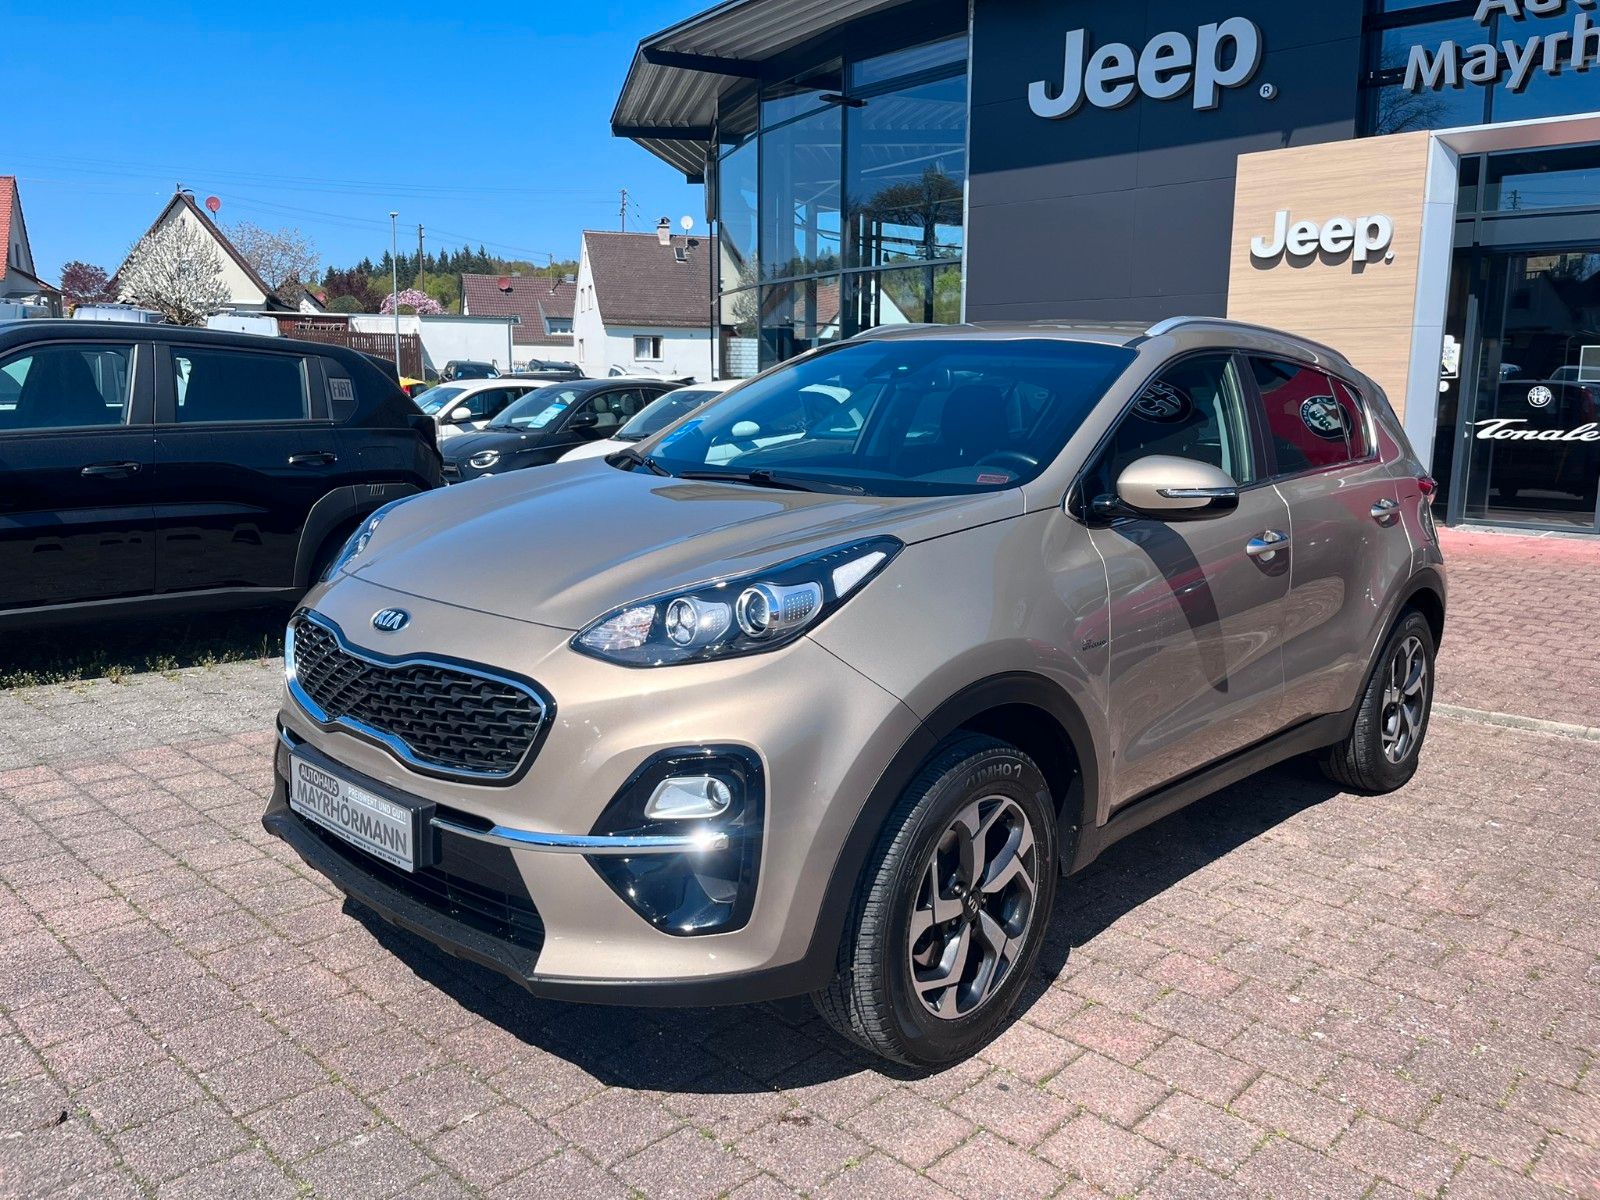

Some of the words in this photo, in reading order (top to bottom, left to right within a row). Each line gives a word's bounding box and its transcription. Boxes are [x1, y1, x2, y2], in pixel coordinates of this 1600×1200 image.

[1028, 16, 1262, 118] Jeep
[1250, 210, 1394, 261] Jeep
[331, 381, 352, 398] FIAT
[1464, 418, 1600, 441] Tonale
[374, 610, 404, 630] KIA
[300, 765, 338, 796] AUTOHAUS
[296, 780, 407, 856] MAYRHÖRMANN
